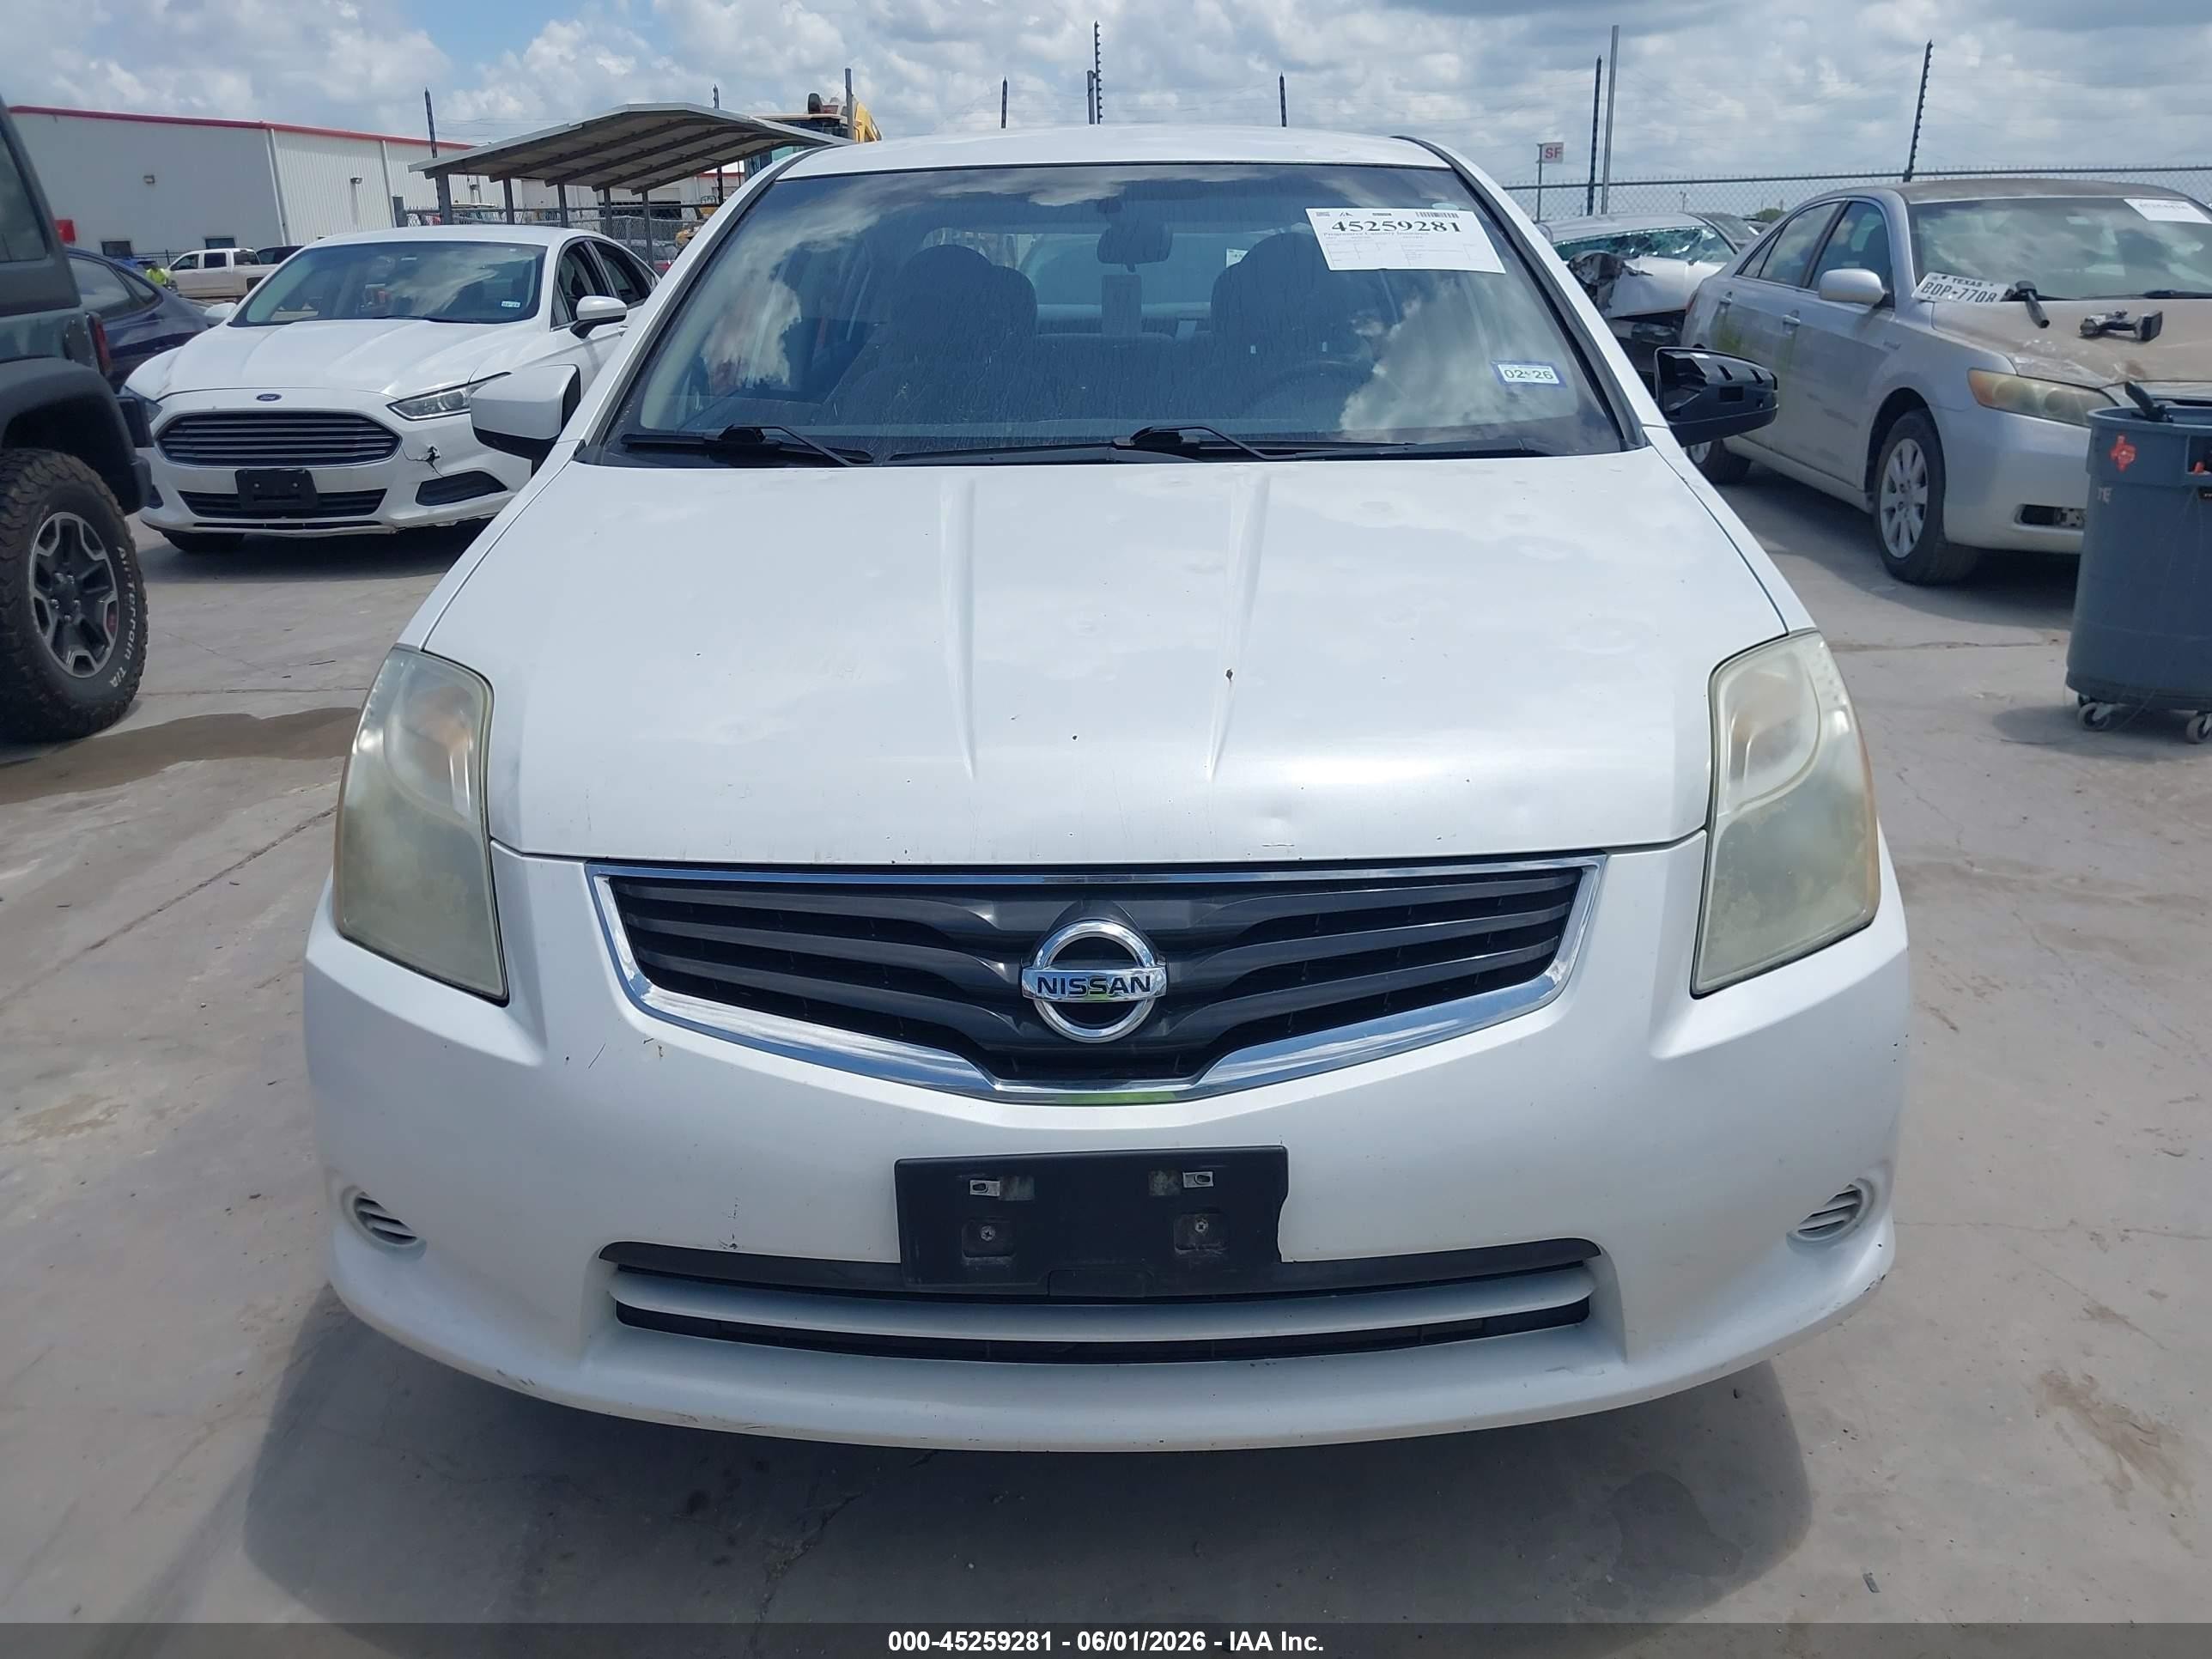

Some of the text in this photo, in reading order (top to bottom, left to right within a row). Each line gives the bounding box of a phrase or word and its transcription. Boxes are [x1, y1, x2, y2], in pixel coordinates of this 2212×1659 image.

[1545, 147, 1563, 159] SF
[1331, 220, 1462, 233] 45259281
[1952, 277, 1983, 288] TEXAS
[1037, 975, 1151, 995] NISSAN
